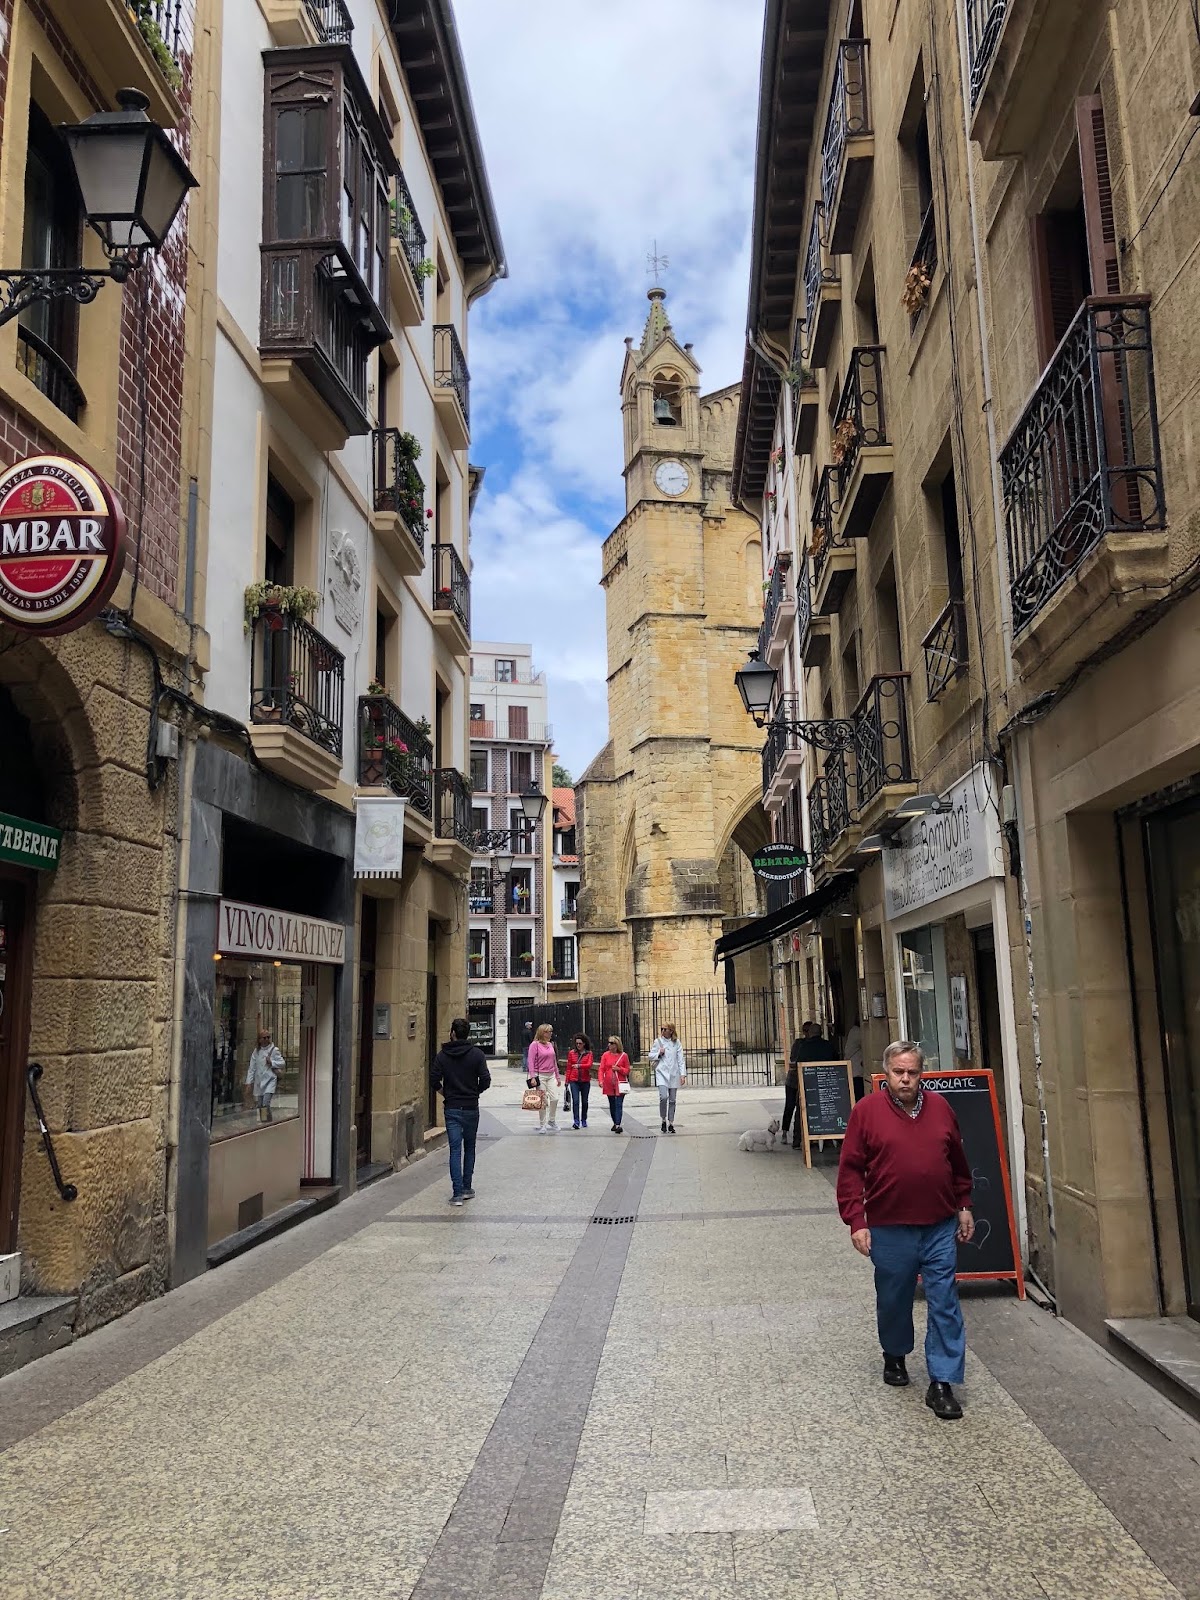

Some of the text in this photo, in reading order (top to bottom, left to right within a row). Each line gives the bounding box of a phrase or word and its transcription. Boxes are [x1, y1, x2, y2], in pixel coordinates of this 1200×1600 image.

[0, 466, 88, 503] RVEZA ESPECIAL
[0, 519, 106, 555] MBAR
[35, 589, 70, 609] DESDE
[69, 567, 87, 590] 1900
[763, 844, 794, 853] TABERNA
[757, 867, 804, 881] SAGARDOTEGIA
[224, 905, 344, 958] VINOS MARTINEZ
